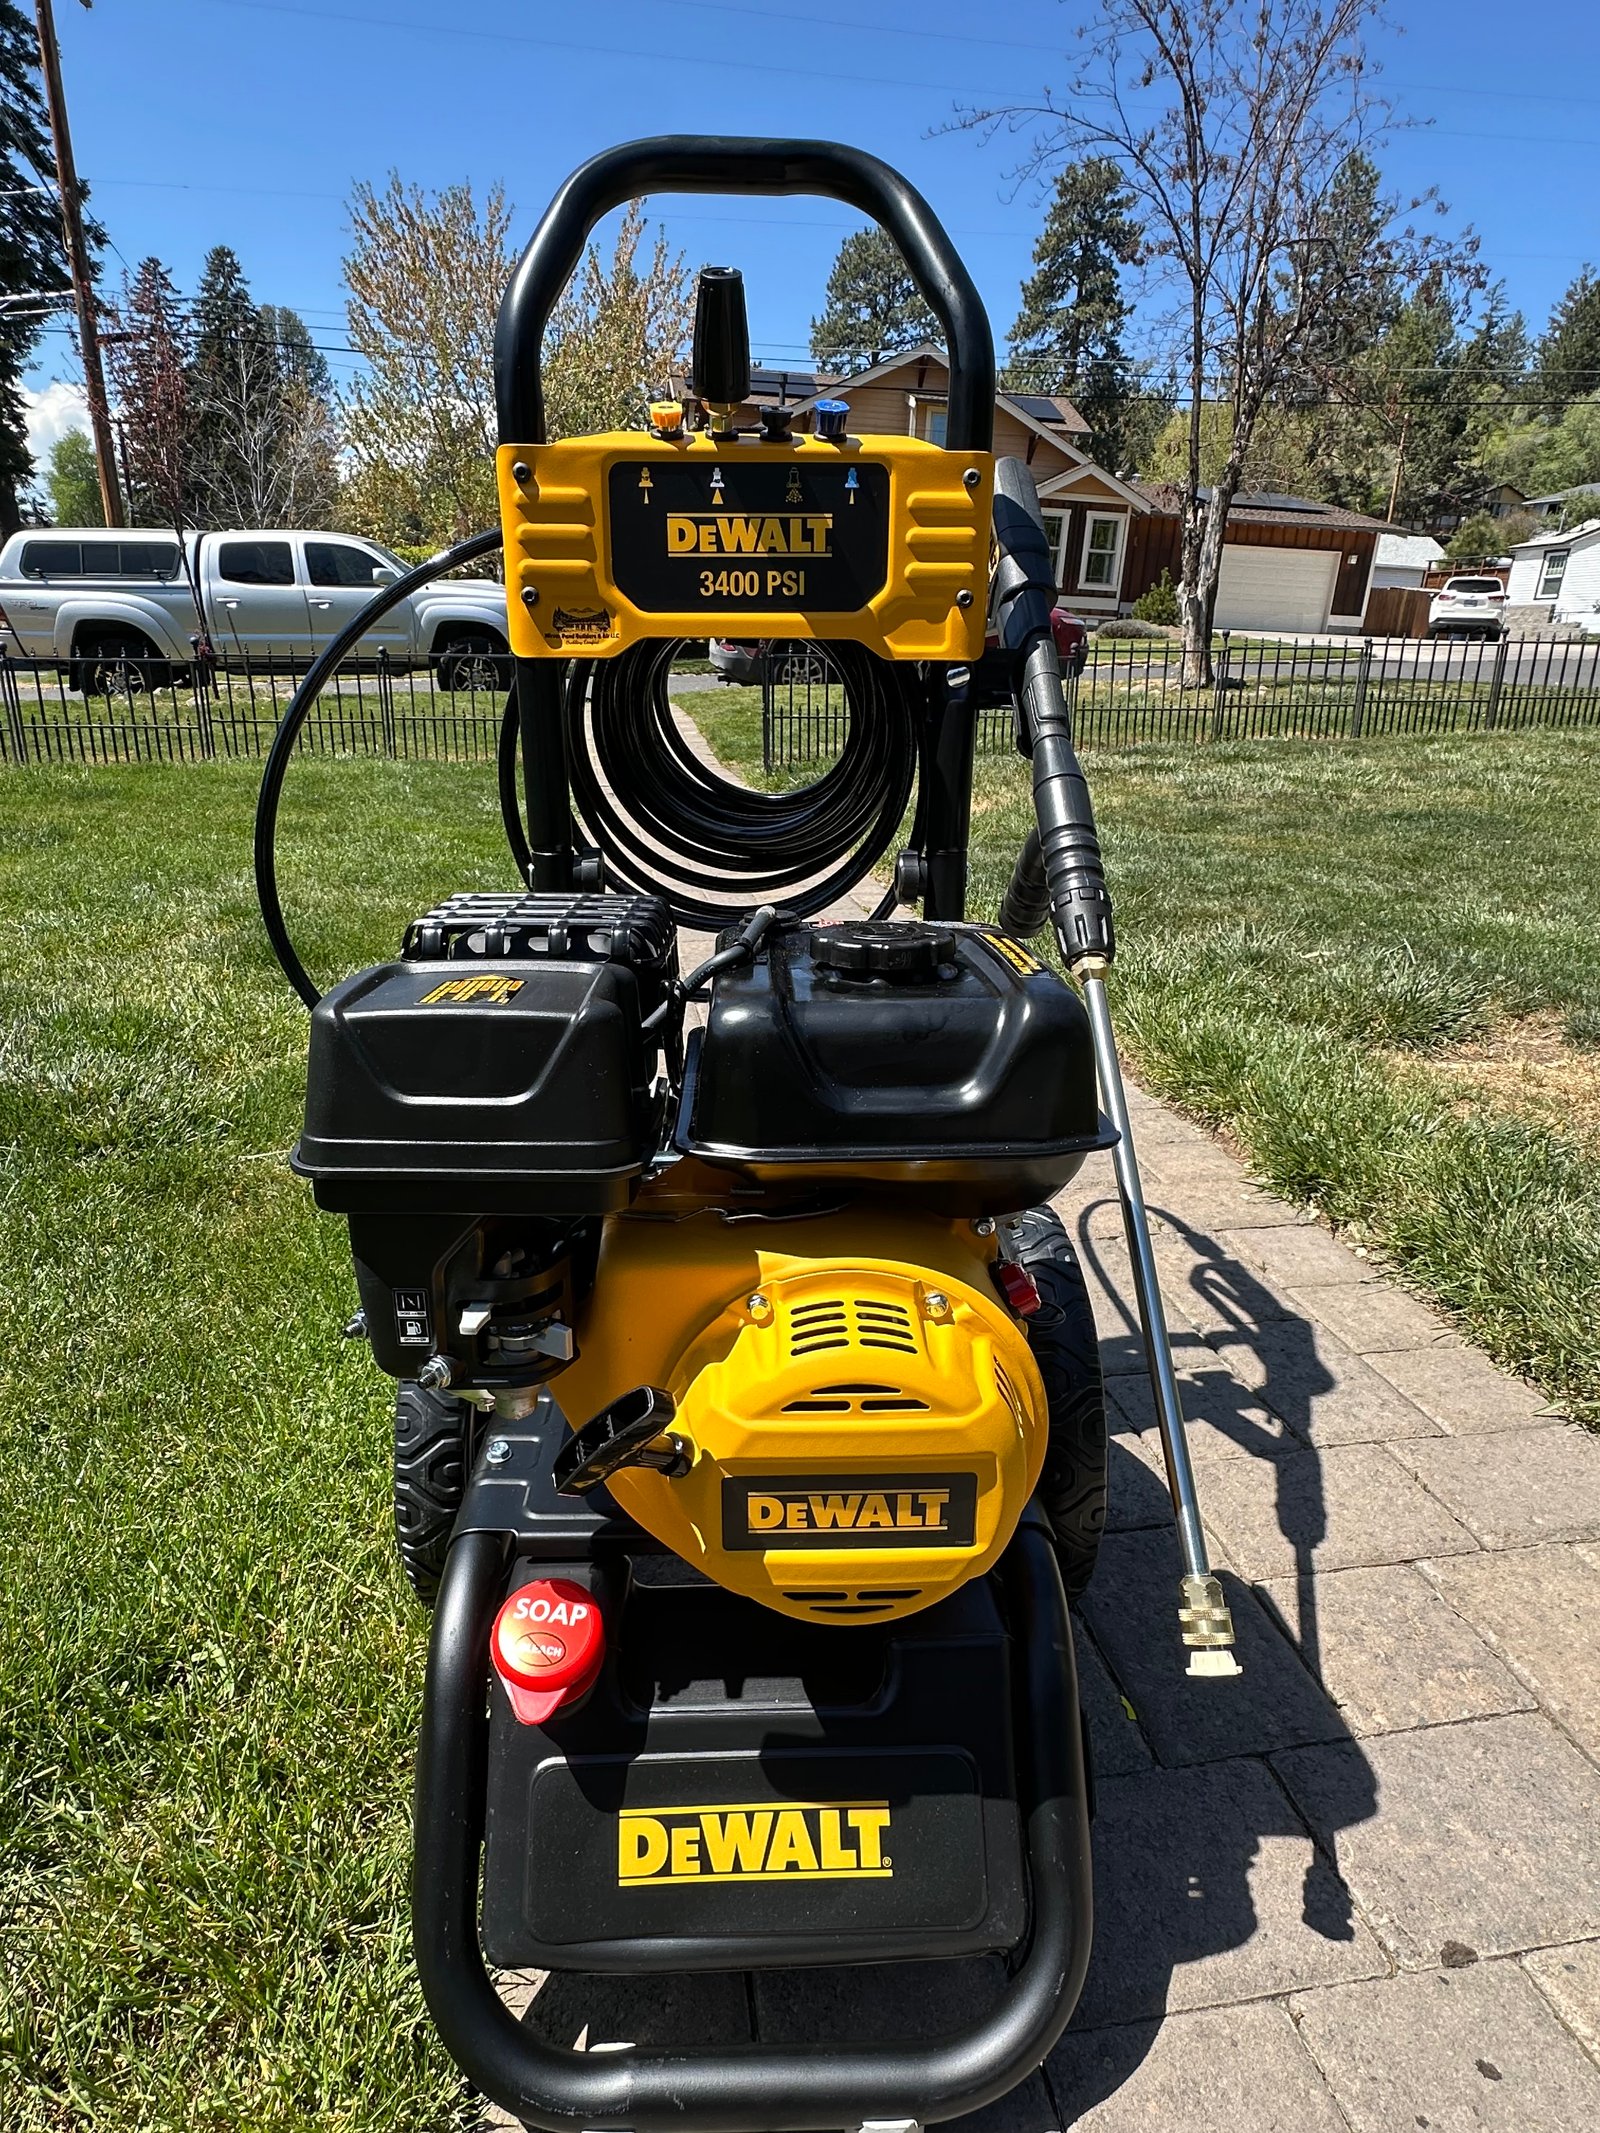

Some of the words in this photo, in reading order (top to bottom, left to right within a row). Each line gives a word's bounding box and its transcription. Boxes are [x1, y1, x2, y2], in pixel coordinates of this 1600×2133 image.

[667, 518, 833, 552] DEWALT
[700, 570, 760, 597] 3400
[766, 570, 805, 596] PSI
[747, 1493, 950, 1529] DEWALT
[512, 1597, 588, 1627] SOAP
[618, 1808, 892, 1878] DEWALT
